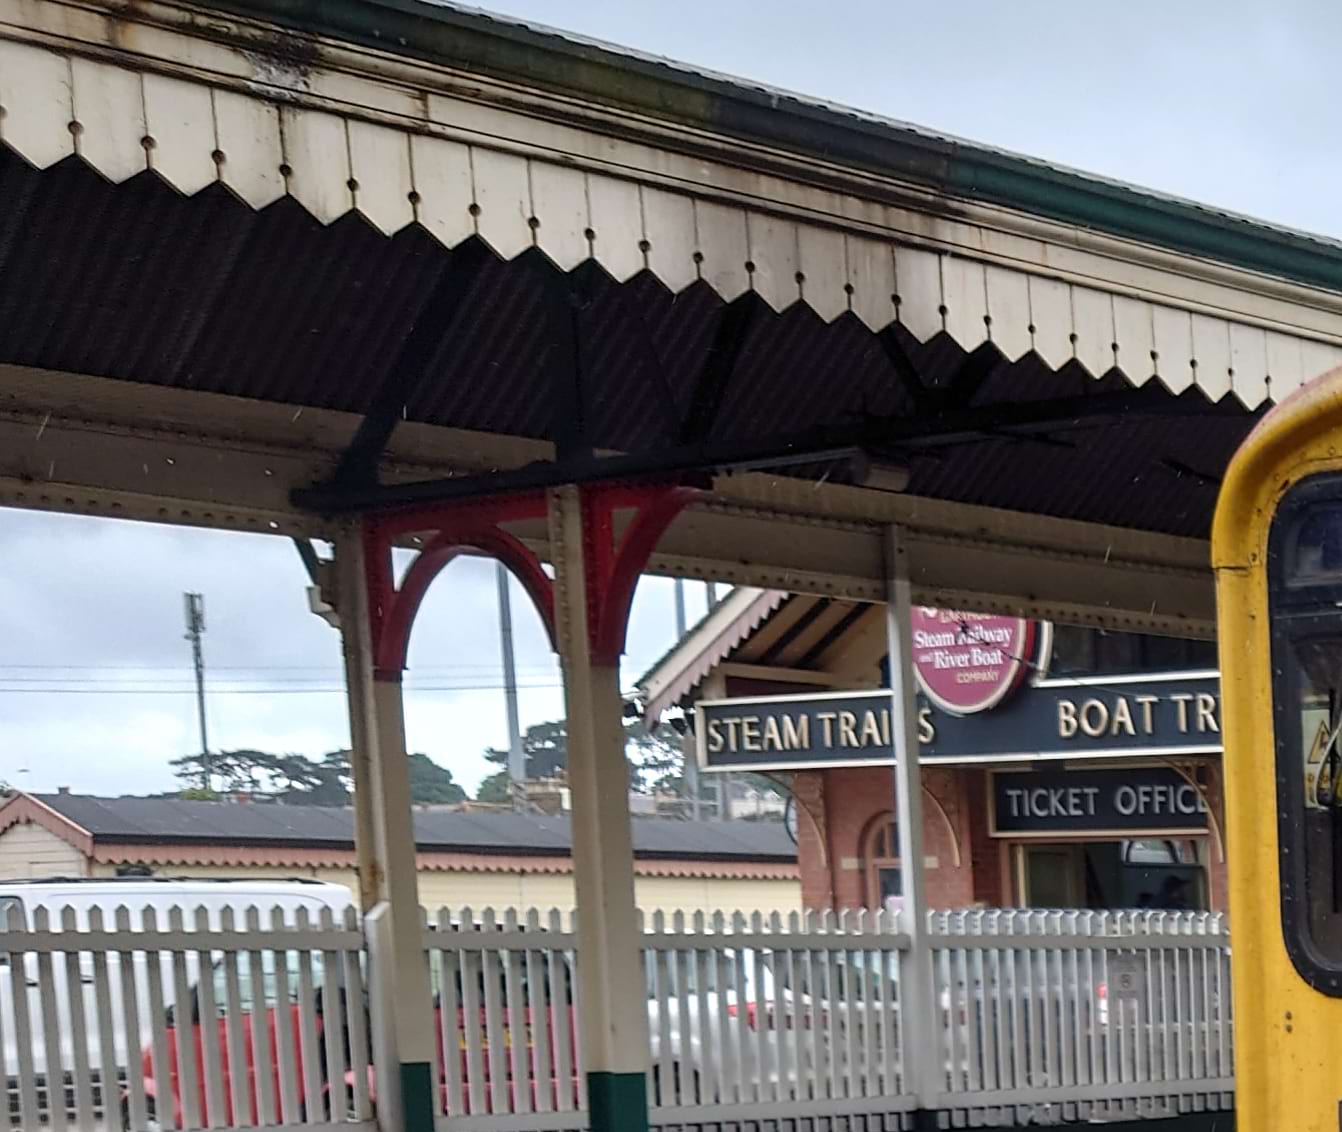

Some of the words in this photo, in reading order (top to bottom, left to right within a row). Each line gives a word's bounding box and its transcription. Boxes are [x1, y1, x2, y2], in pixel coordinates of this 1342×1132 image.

[914, 630, 956, 649] Steam
[933, 649, 970, 669] River
[970, 647, 1004, 667] Boat
[956, 669, 999, 684] COMPANY
[709, 715, 810, 752] STEAM
[816, 707, 935, 748] TRAIS
[1058, 696, 1160, 738] BOAT
[1006, 787, 1099, 817] TICKET
